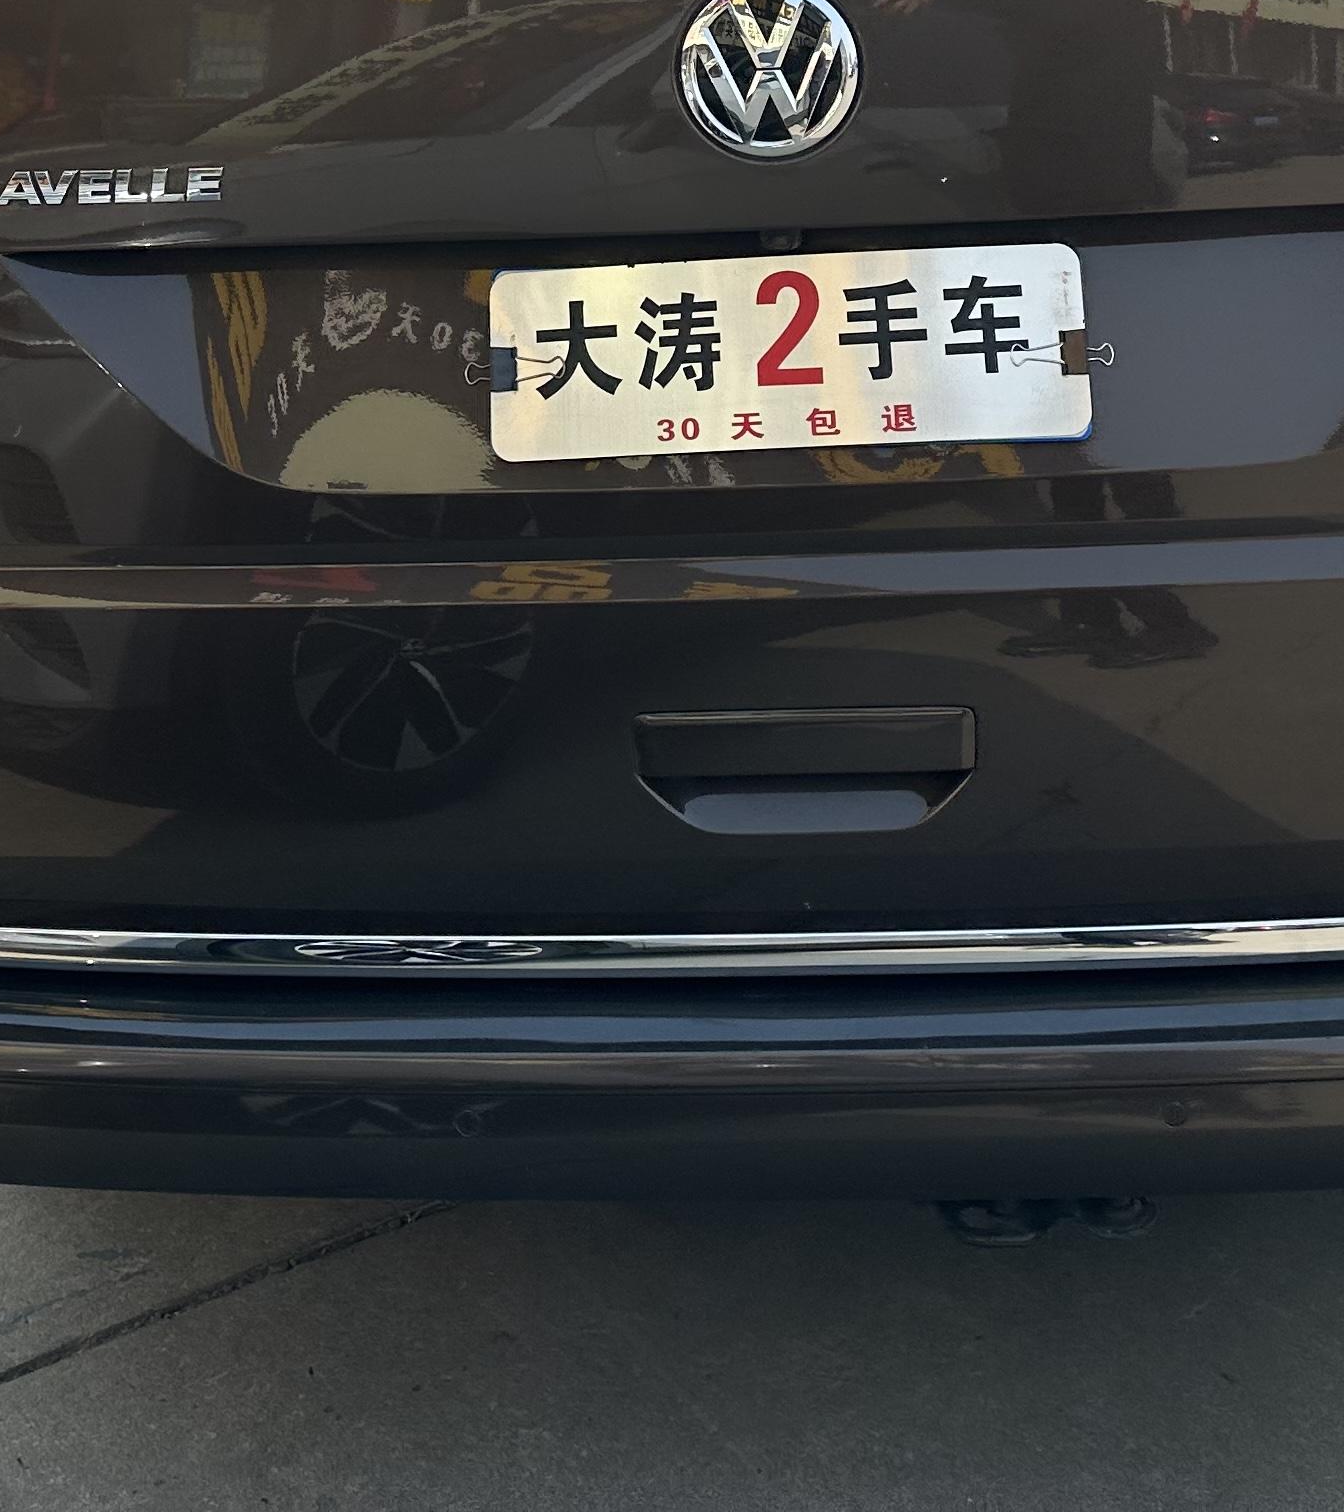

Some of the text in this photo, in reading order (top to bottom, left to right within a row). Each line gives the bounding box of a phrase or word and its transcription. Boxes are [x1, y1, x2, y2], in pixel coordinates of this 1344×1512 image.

[535, 269, 1029, 400] 大涛2手车
[656, 403, 918, 443] 30天包退
